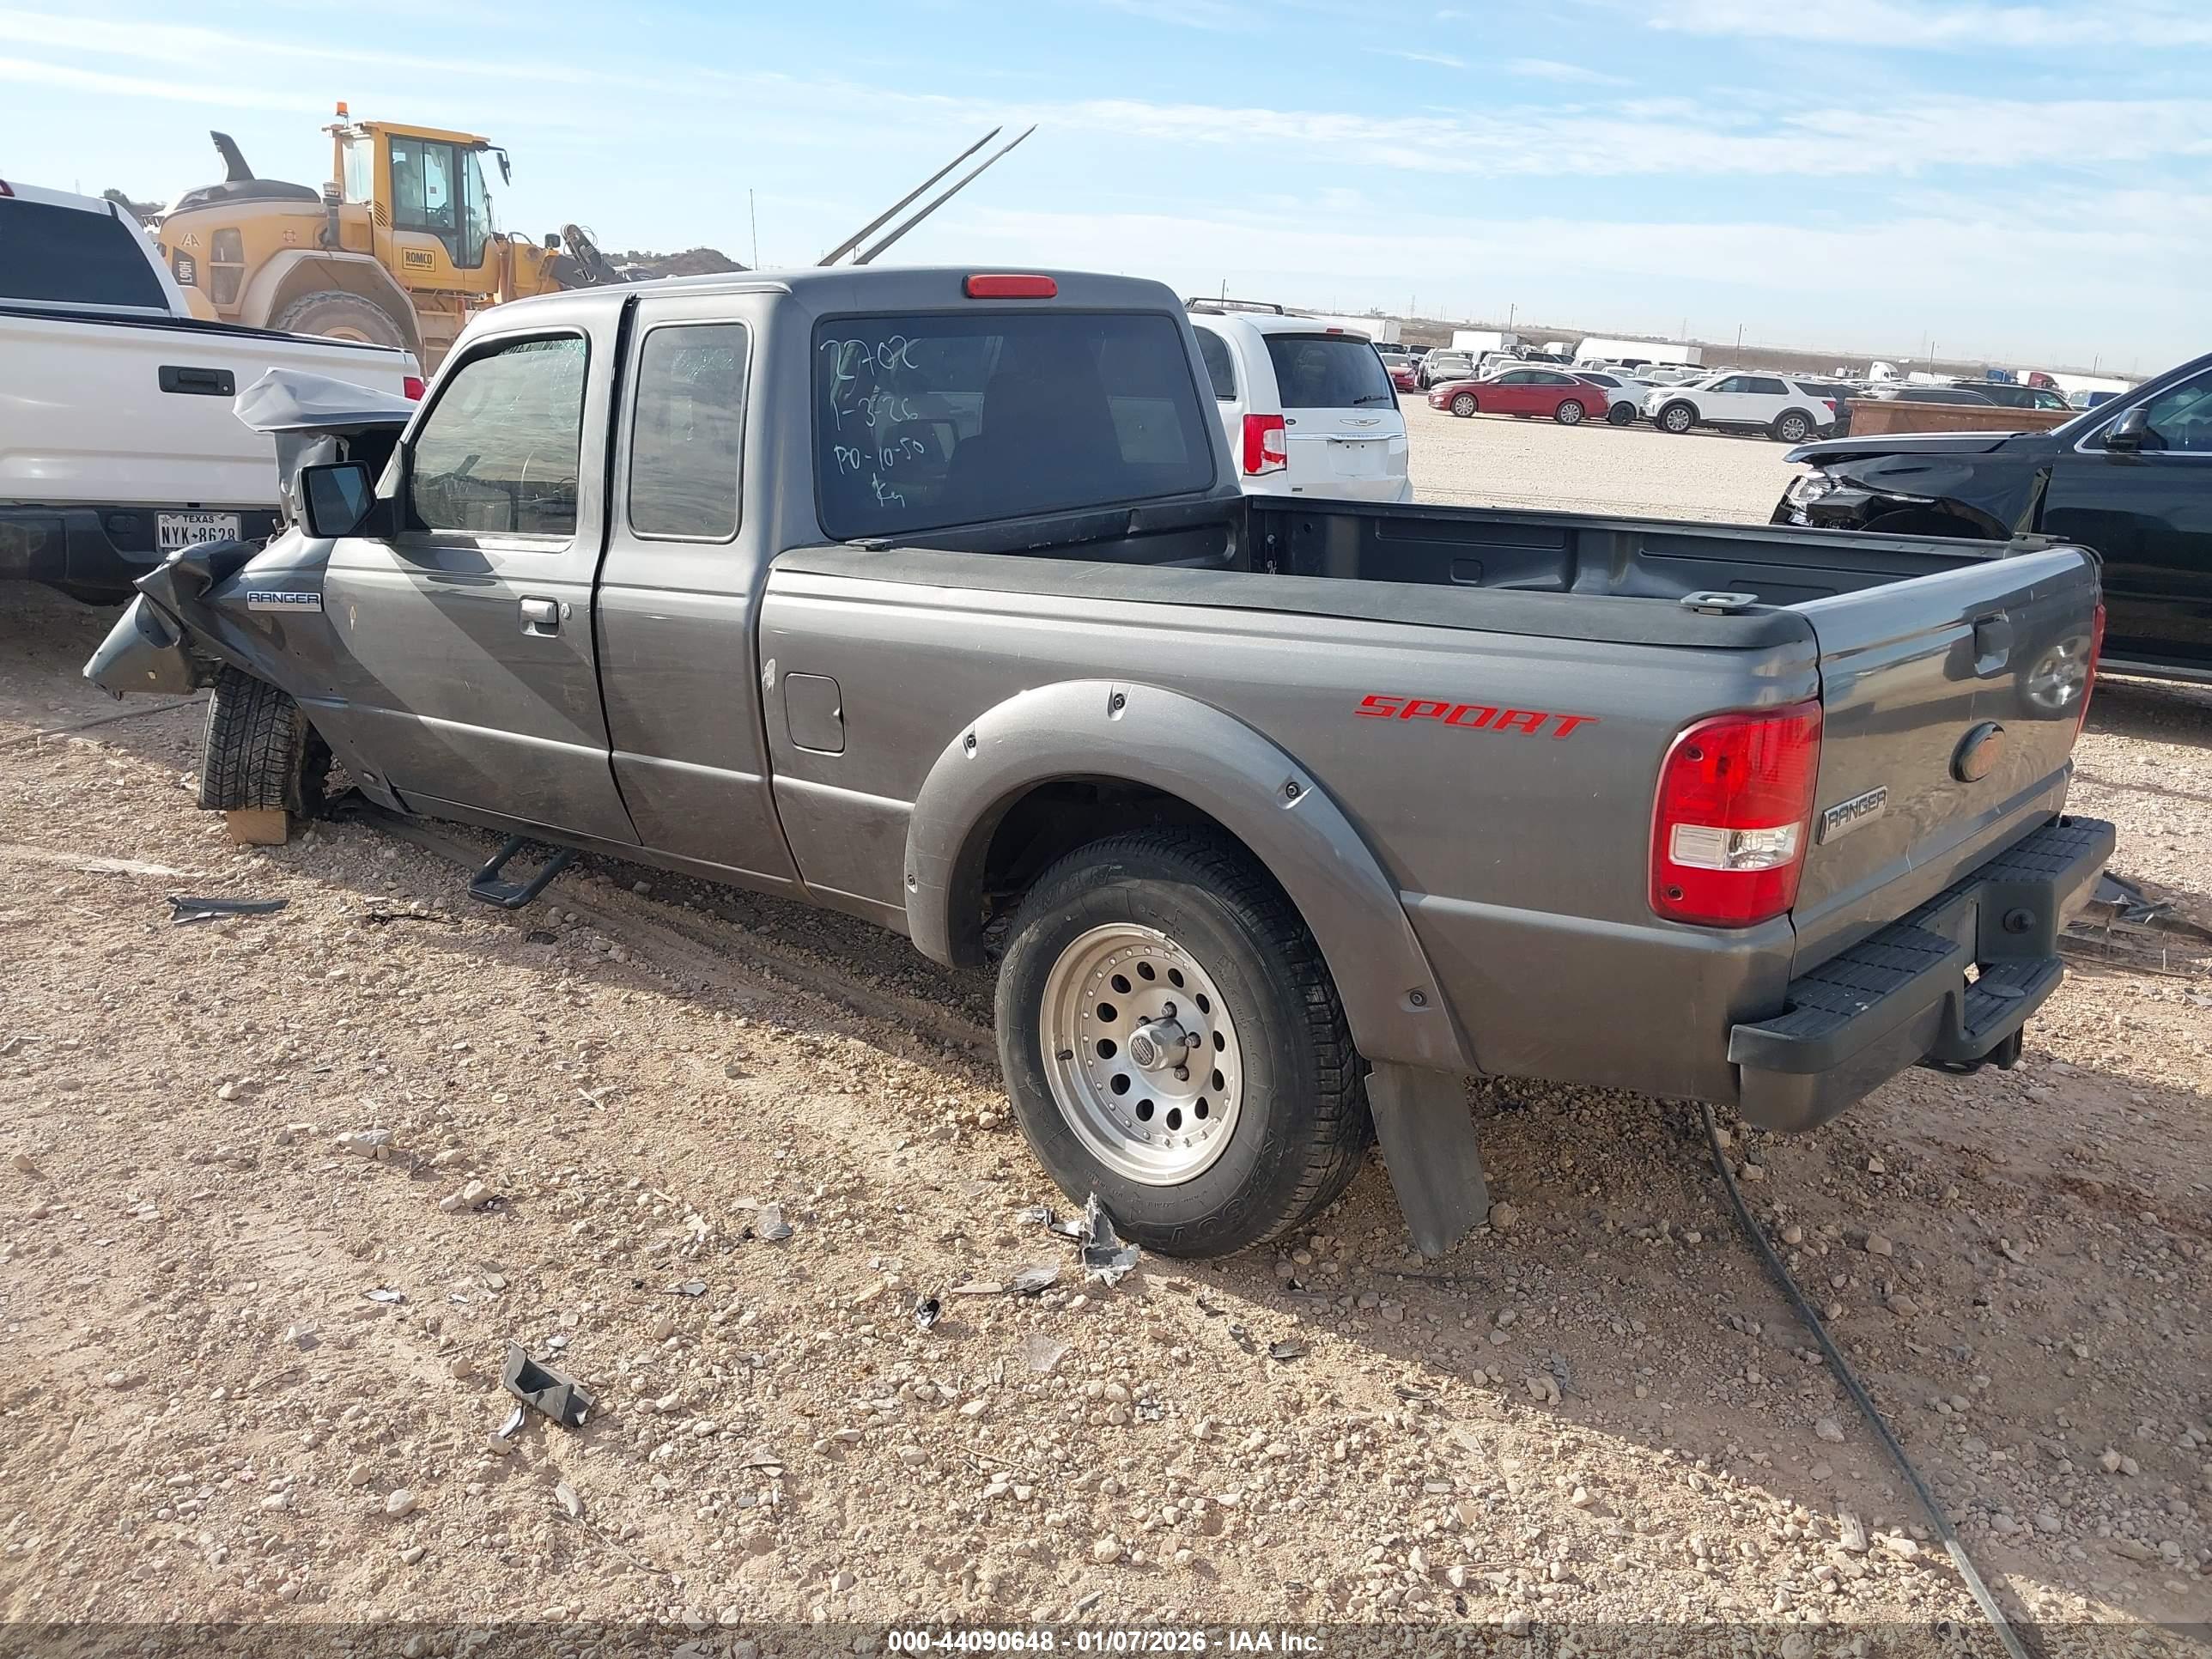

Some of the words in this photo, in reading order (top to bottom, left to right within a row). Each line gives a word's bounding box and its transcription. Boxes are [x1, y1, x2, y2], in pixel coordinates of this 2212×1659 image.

[405, 251, 433, 264] ROMCO
[182, 514, 215, 524] TEXAS
[161, 526, 190, 544] NYK
[248, 592, 319, 604] RANGER
[1354, 695, 1601, 738] SPORT
[1827, 788, 1887, 832] RANGER
